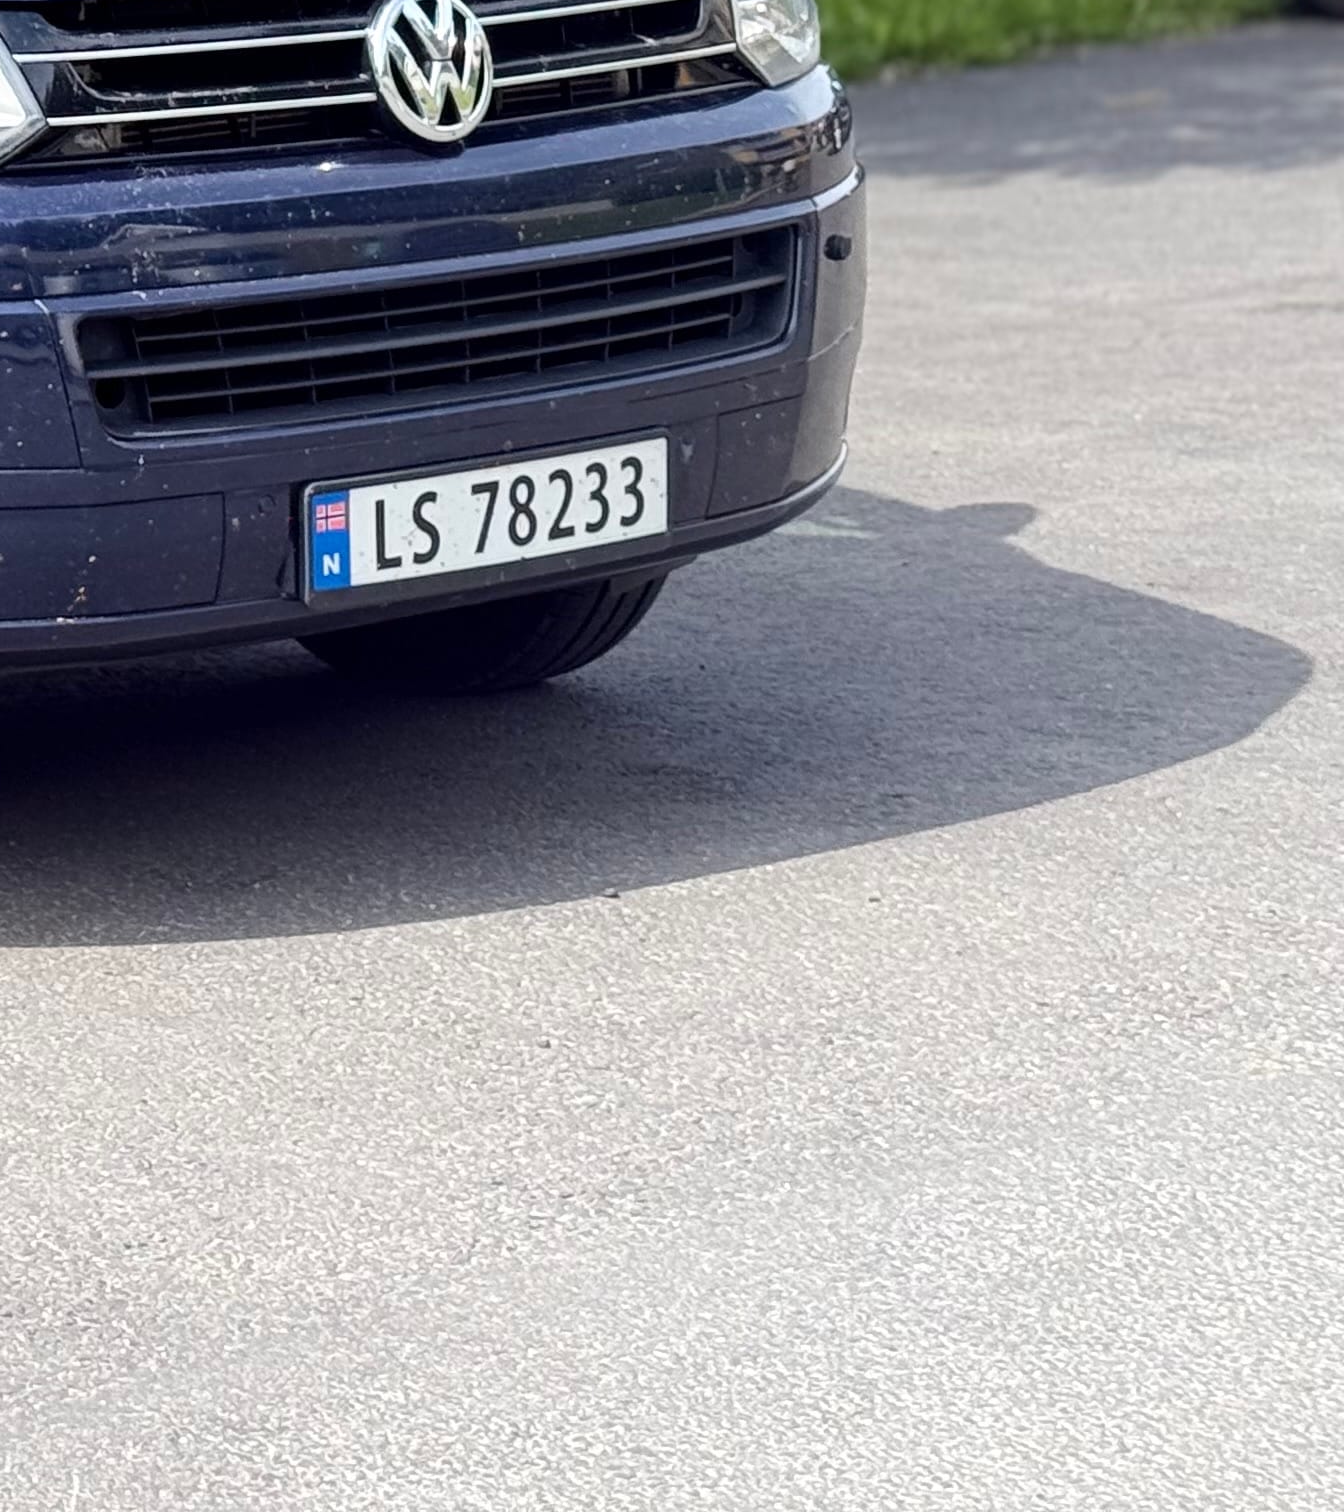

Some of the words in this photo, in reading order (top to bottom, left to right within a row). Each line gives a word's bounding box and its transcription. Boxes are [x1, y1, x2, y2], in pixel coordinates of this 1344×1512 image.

[375, 491, 440, 569] LS
[471, 456, 645, 554] 78233
[323, 553, 341, 576] N
